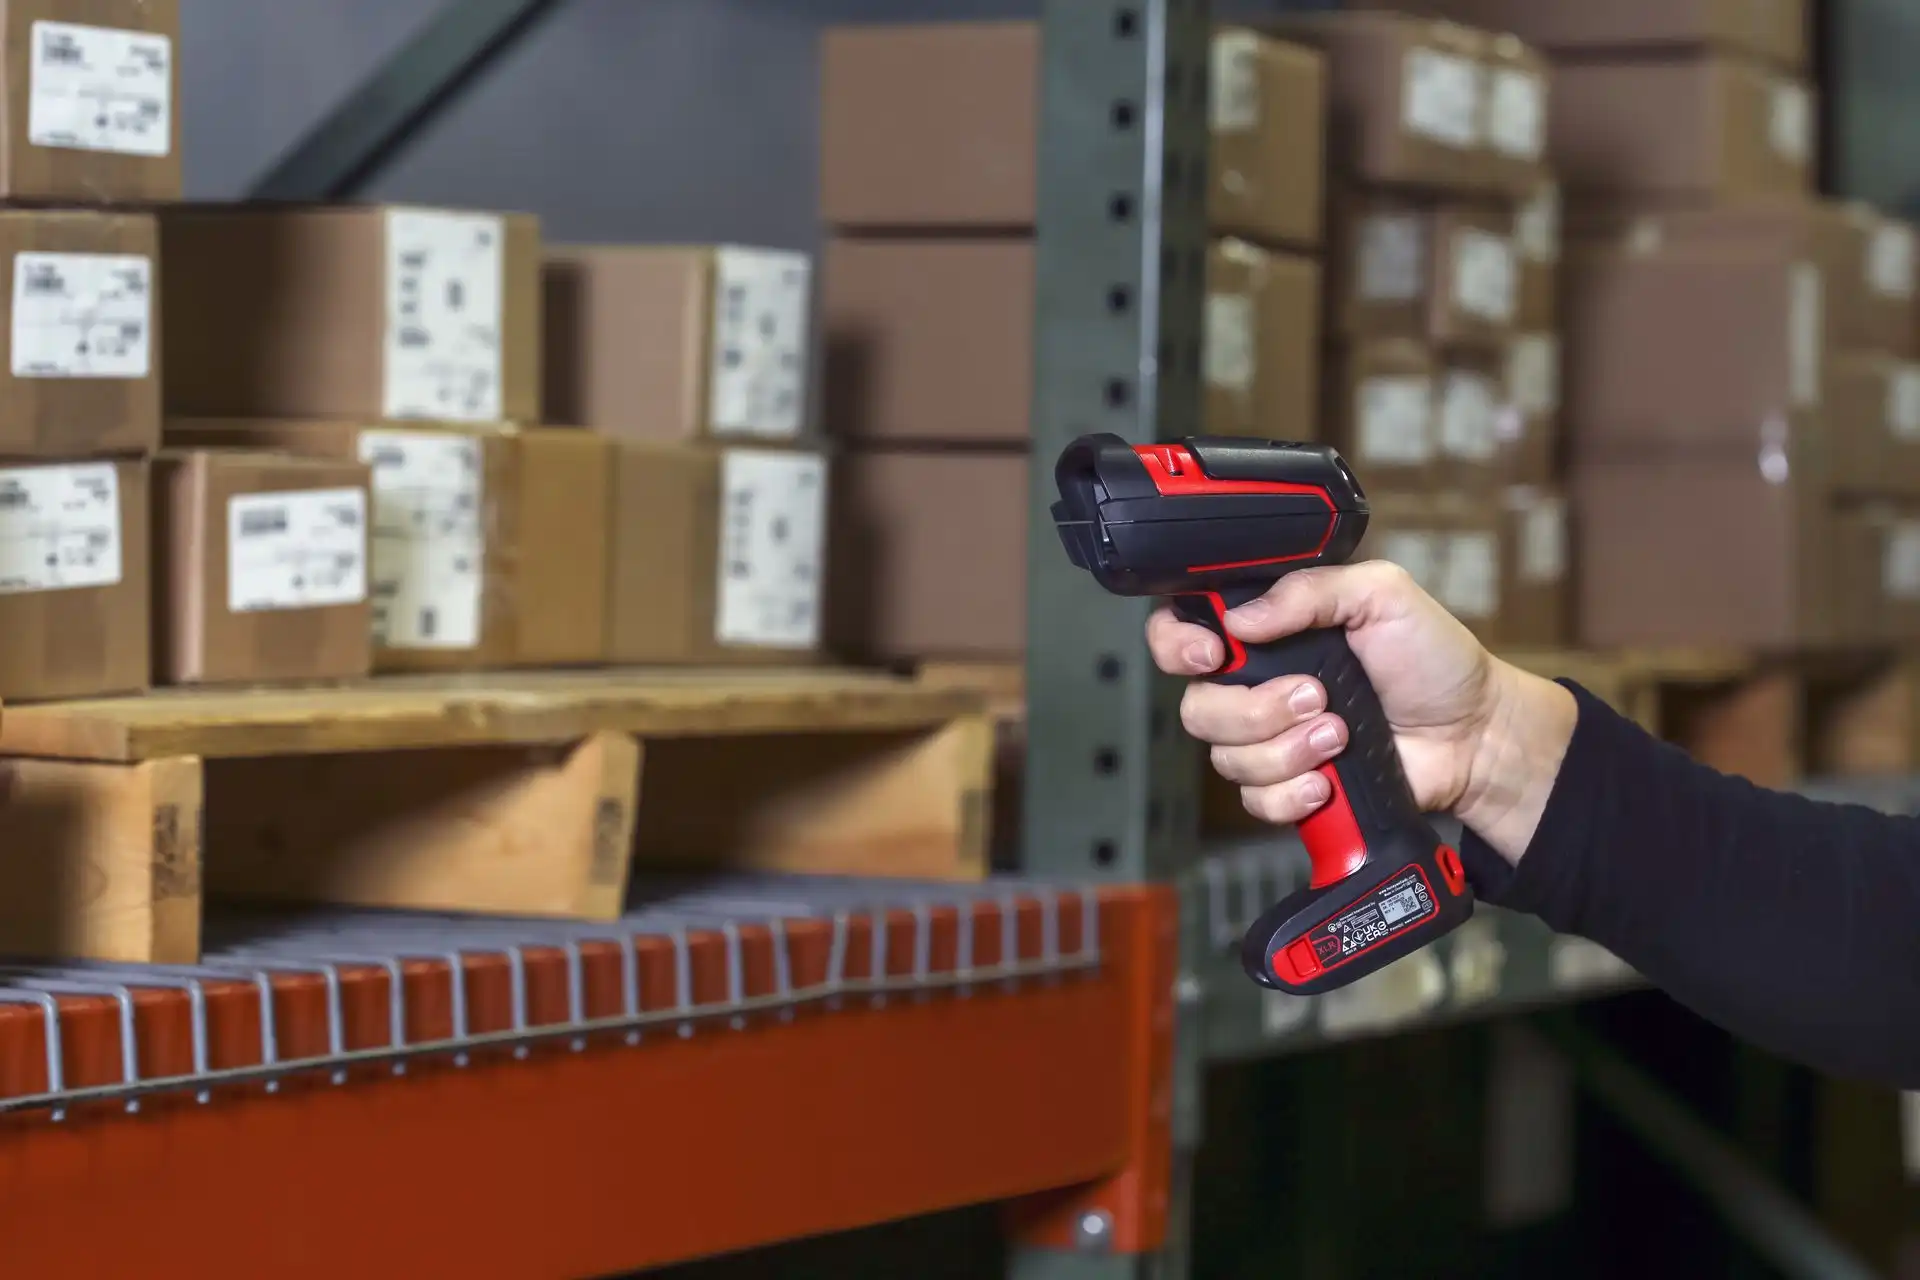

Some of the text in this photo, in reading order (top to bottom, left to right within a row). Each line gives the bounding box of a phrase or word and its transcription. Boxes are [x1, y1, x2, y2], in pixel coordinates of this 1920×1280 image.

[1363, 922, 1377, 934] UK
[1366, 930, 1380, 941] CA
[1317, 940, 1336, 954] XLR
